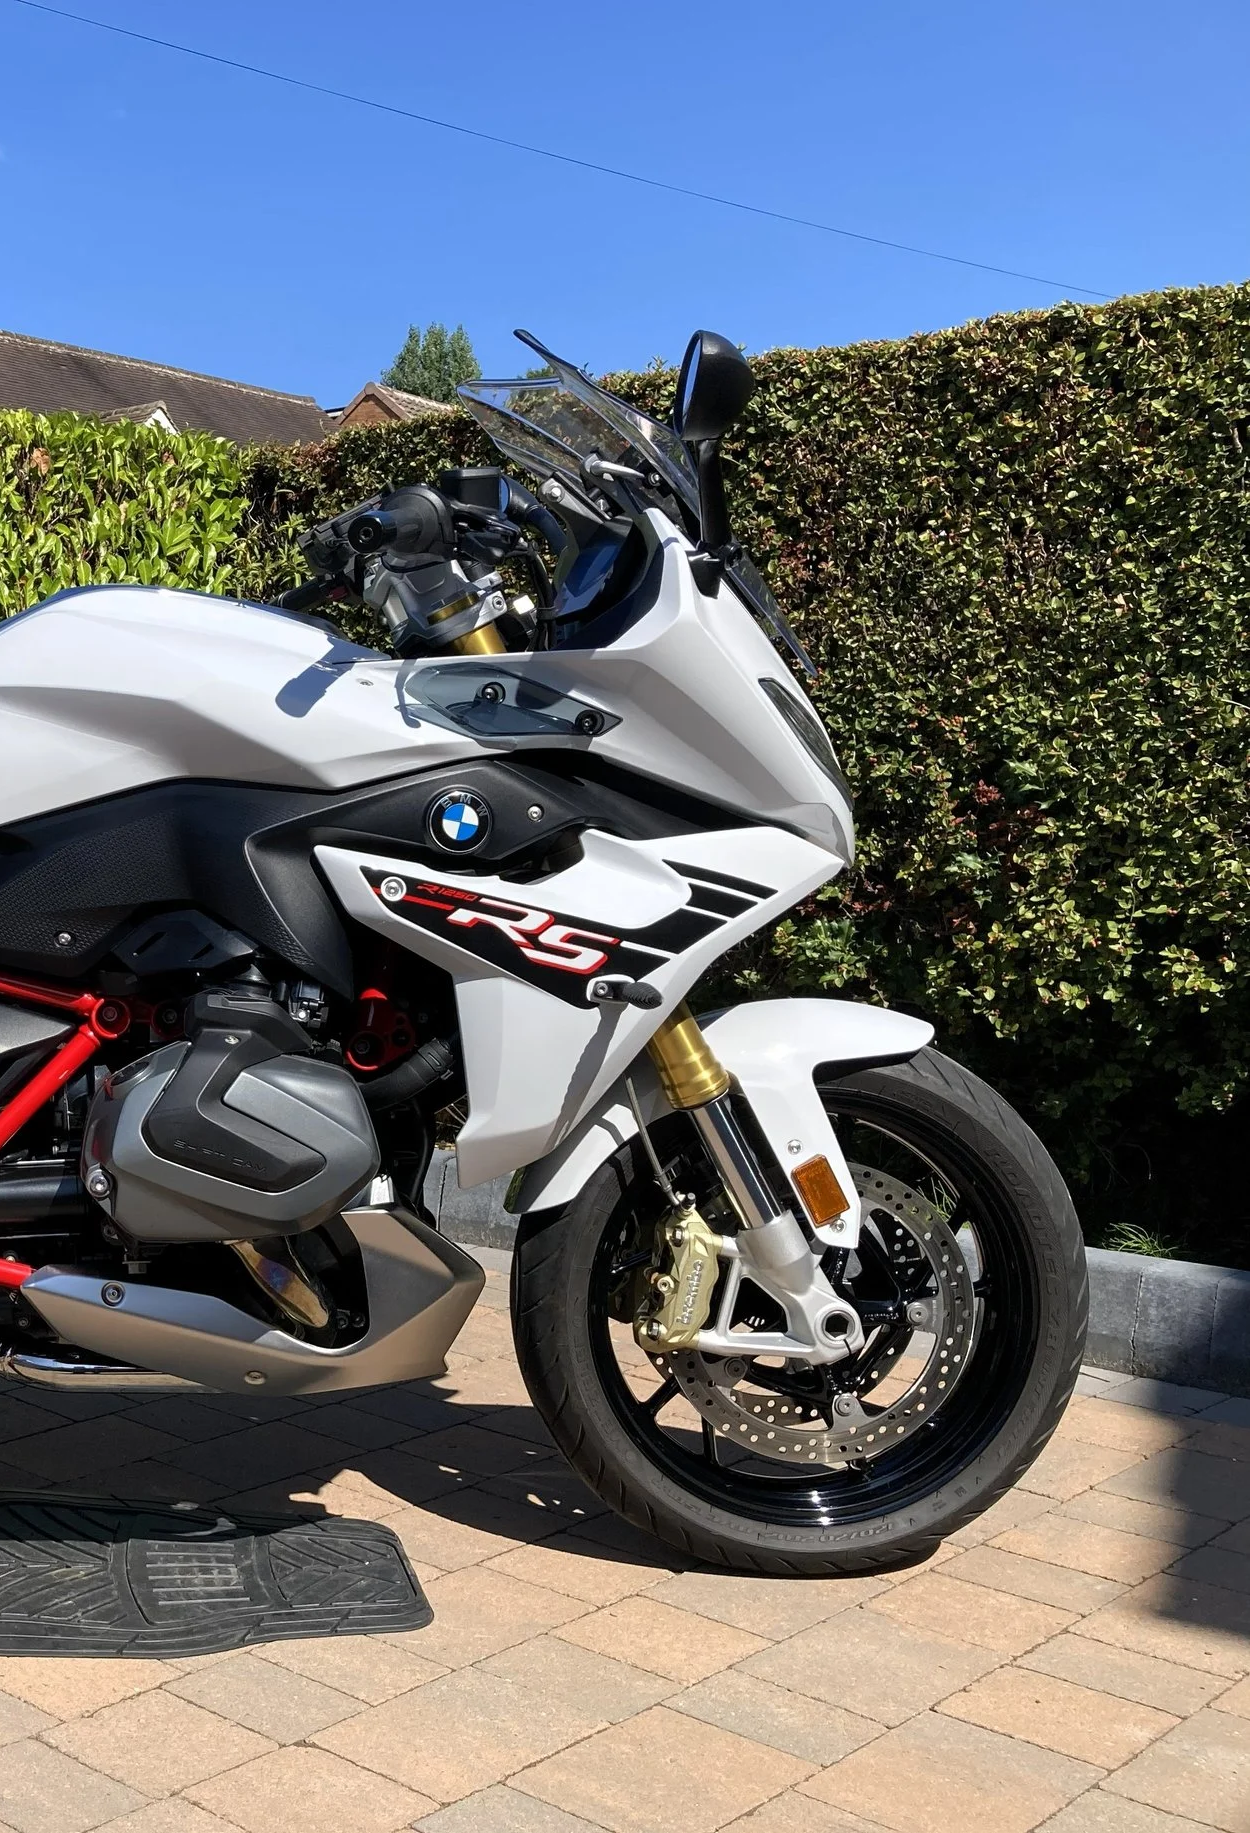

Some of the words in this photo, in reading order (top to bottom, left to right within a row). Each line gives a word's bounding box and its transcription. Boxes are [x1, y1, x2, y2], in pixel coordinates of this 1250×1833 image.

[440, 792, 489, 818] BMW
[446, 897, 620, 975] RS
[675, 1259, 704, 1325] brembo
